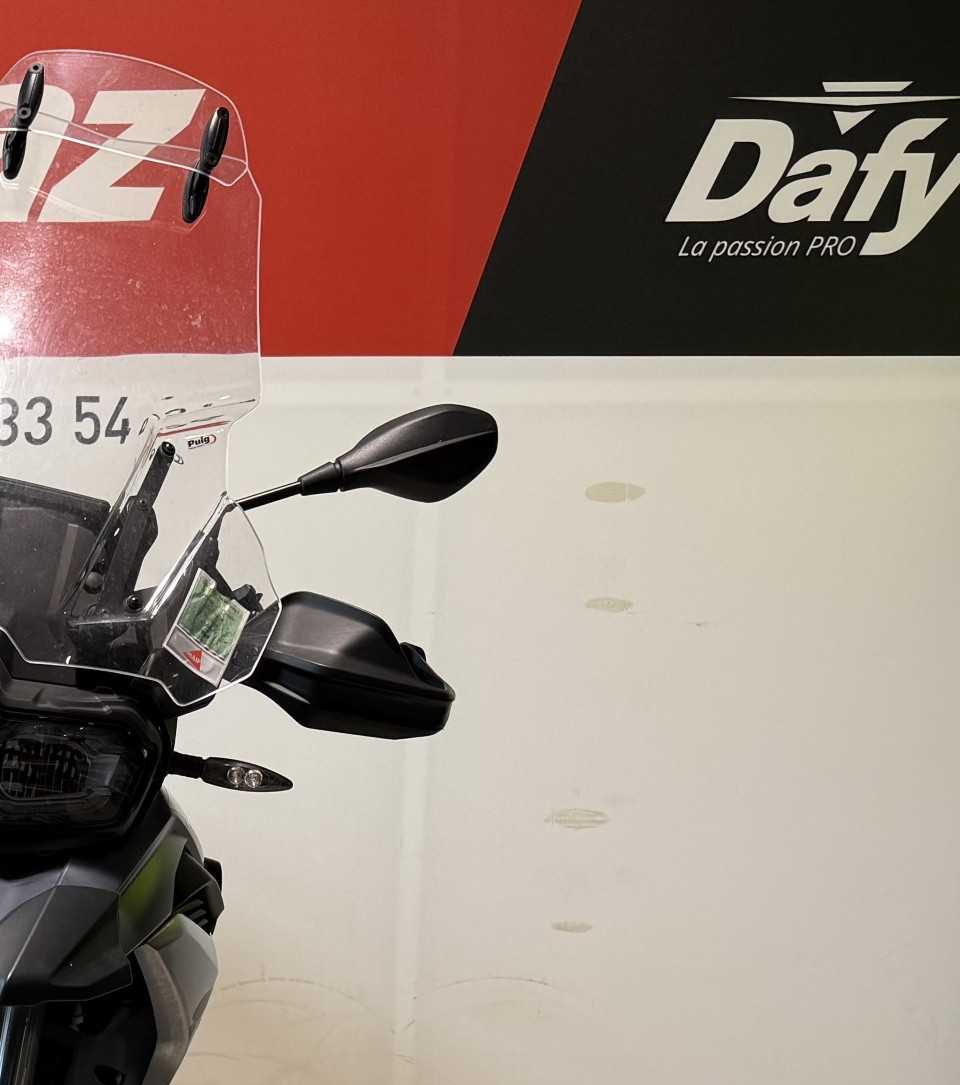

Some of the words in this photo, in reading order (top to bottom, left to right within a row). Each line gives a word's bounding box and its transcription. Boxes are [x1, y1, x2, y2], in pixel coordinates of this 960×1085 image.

[664, 117, 960, 256] Dafy
[678, 236, 707, 257] La
[709, 235, 800, 262] passion
[806, 236, 856, 256] PRO
[187, 435, 210, 448] Puig
